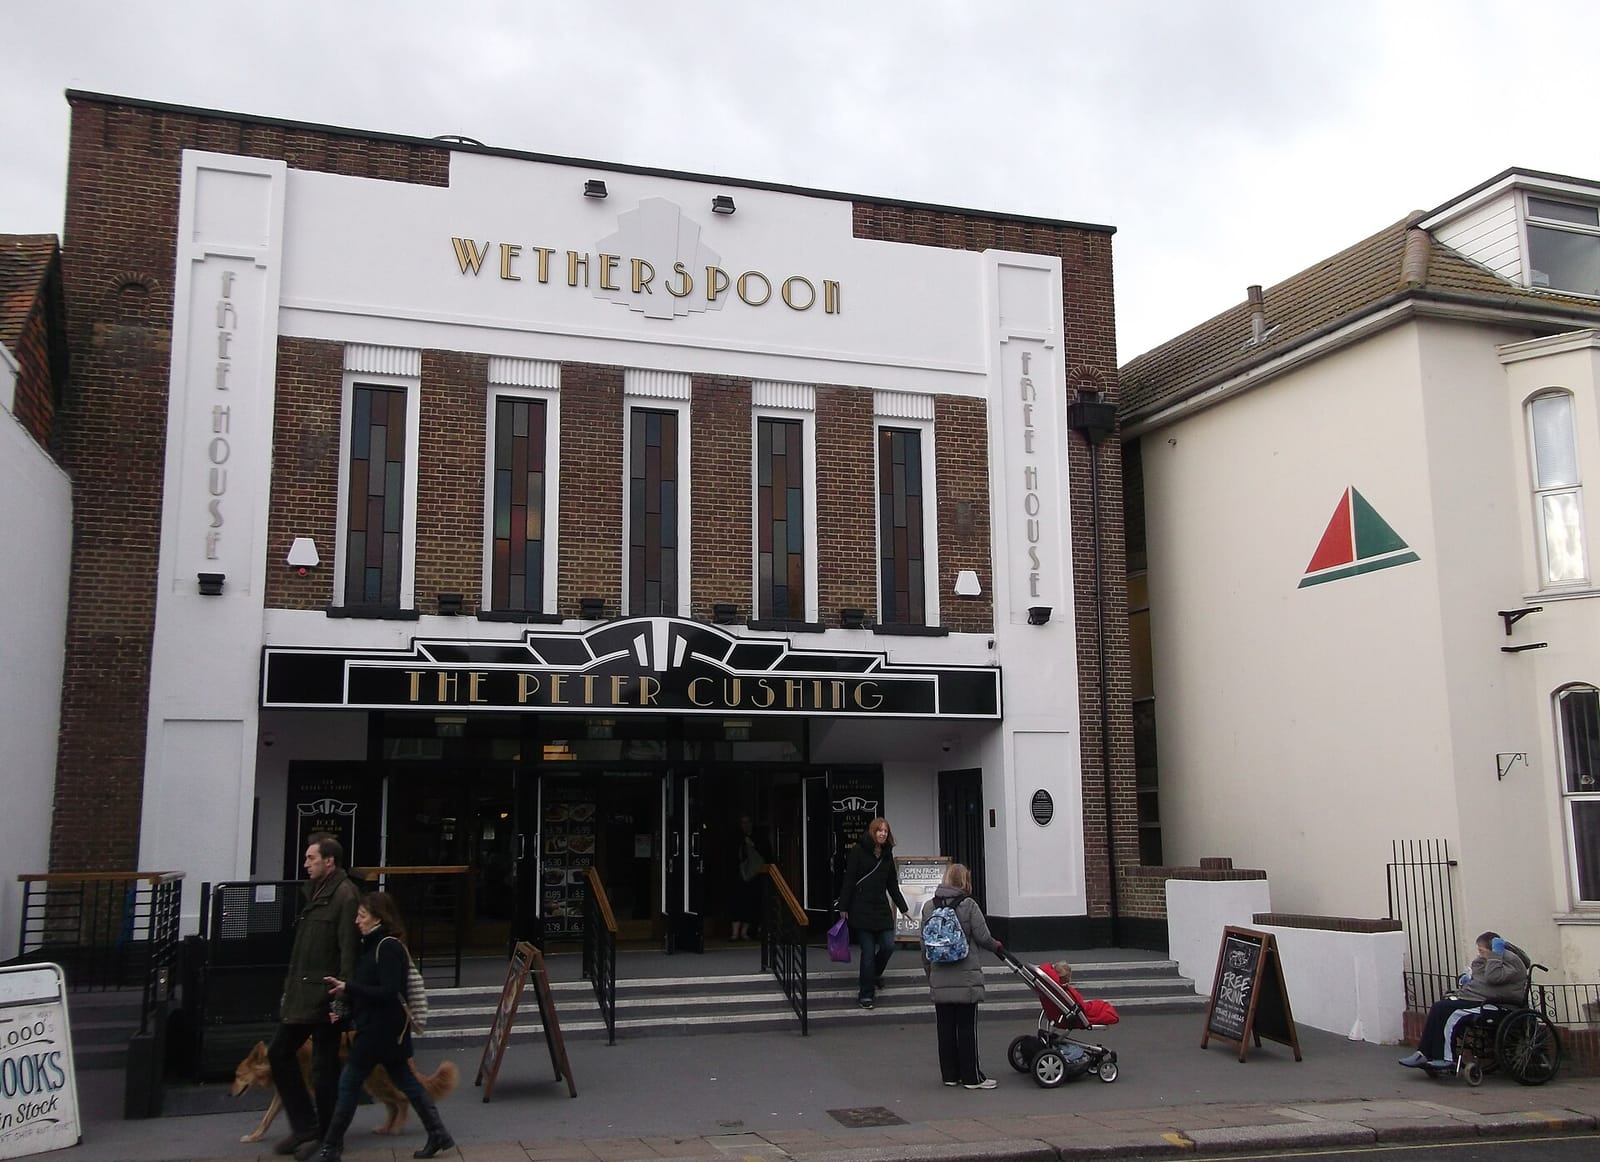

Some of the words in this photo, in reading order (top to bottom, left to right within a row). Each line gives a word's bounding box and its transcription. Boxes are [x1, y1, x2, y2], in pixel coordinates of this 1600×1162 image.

[451, 235, 841, 315] WETHERSPOON
[216, 270, 238, 392] FREE
[1020, 351, 1037, 454] FREE
[205, 404, 231, 561] HOUSE
[1024, 465, 1041, 598] HOUSE
[405, 671, 488, 702] THE
[517, 673, 661, 706] PETER
[688, 677, 884, 710] CUSHING
[1220, 985, 1248, 1006] DRINK
[1223, 971, 1250, 991] FREE
[0, 1051, 65, 1098] OOKS
[16, 1095, 59, 1124] Stock
